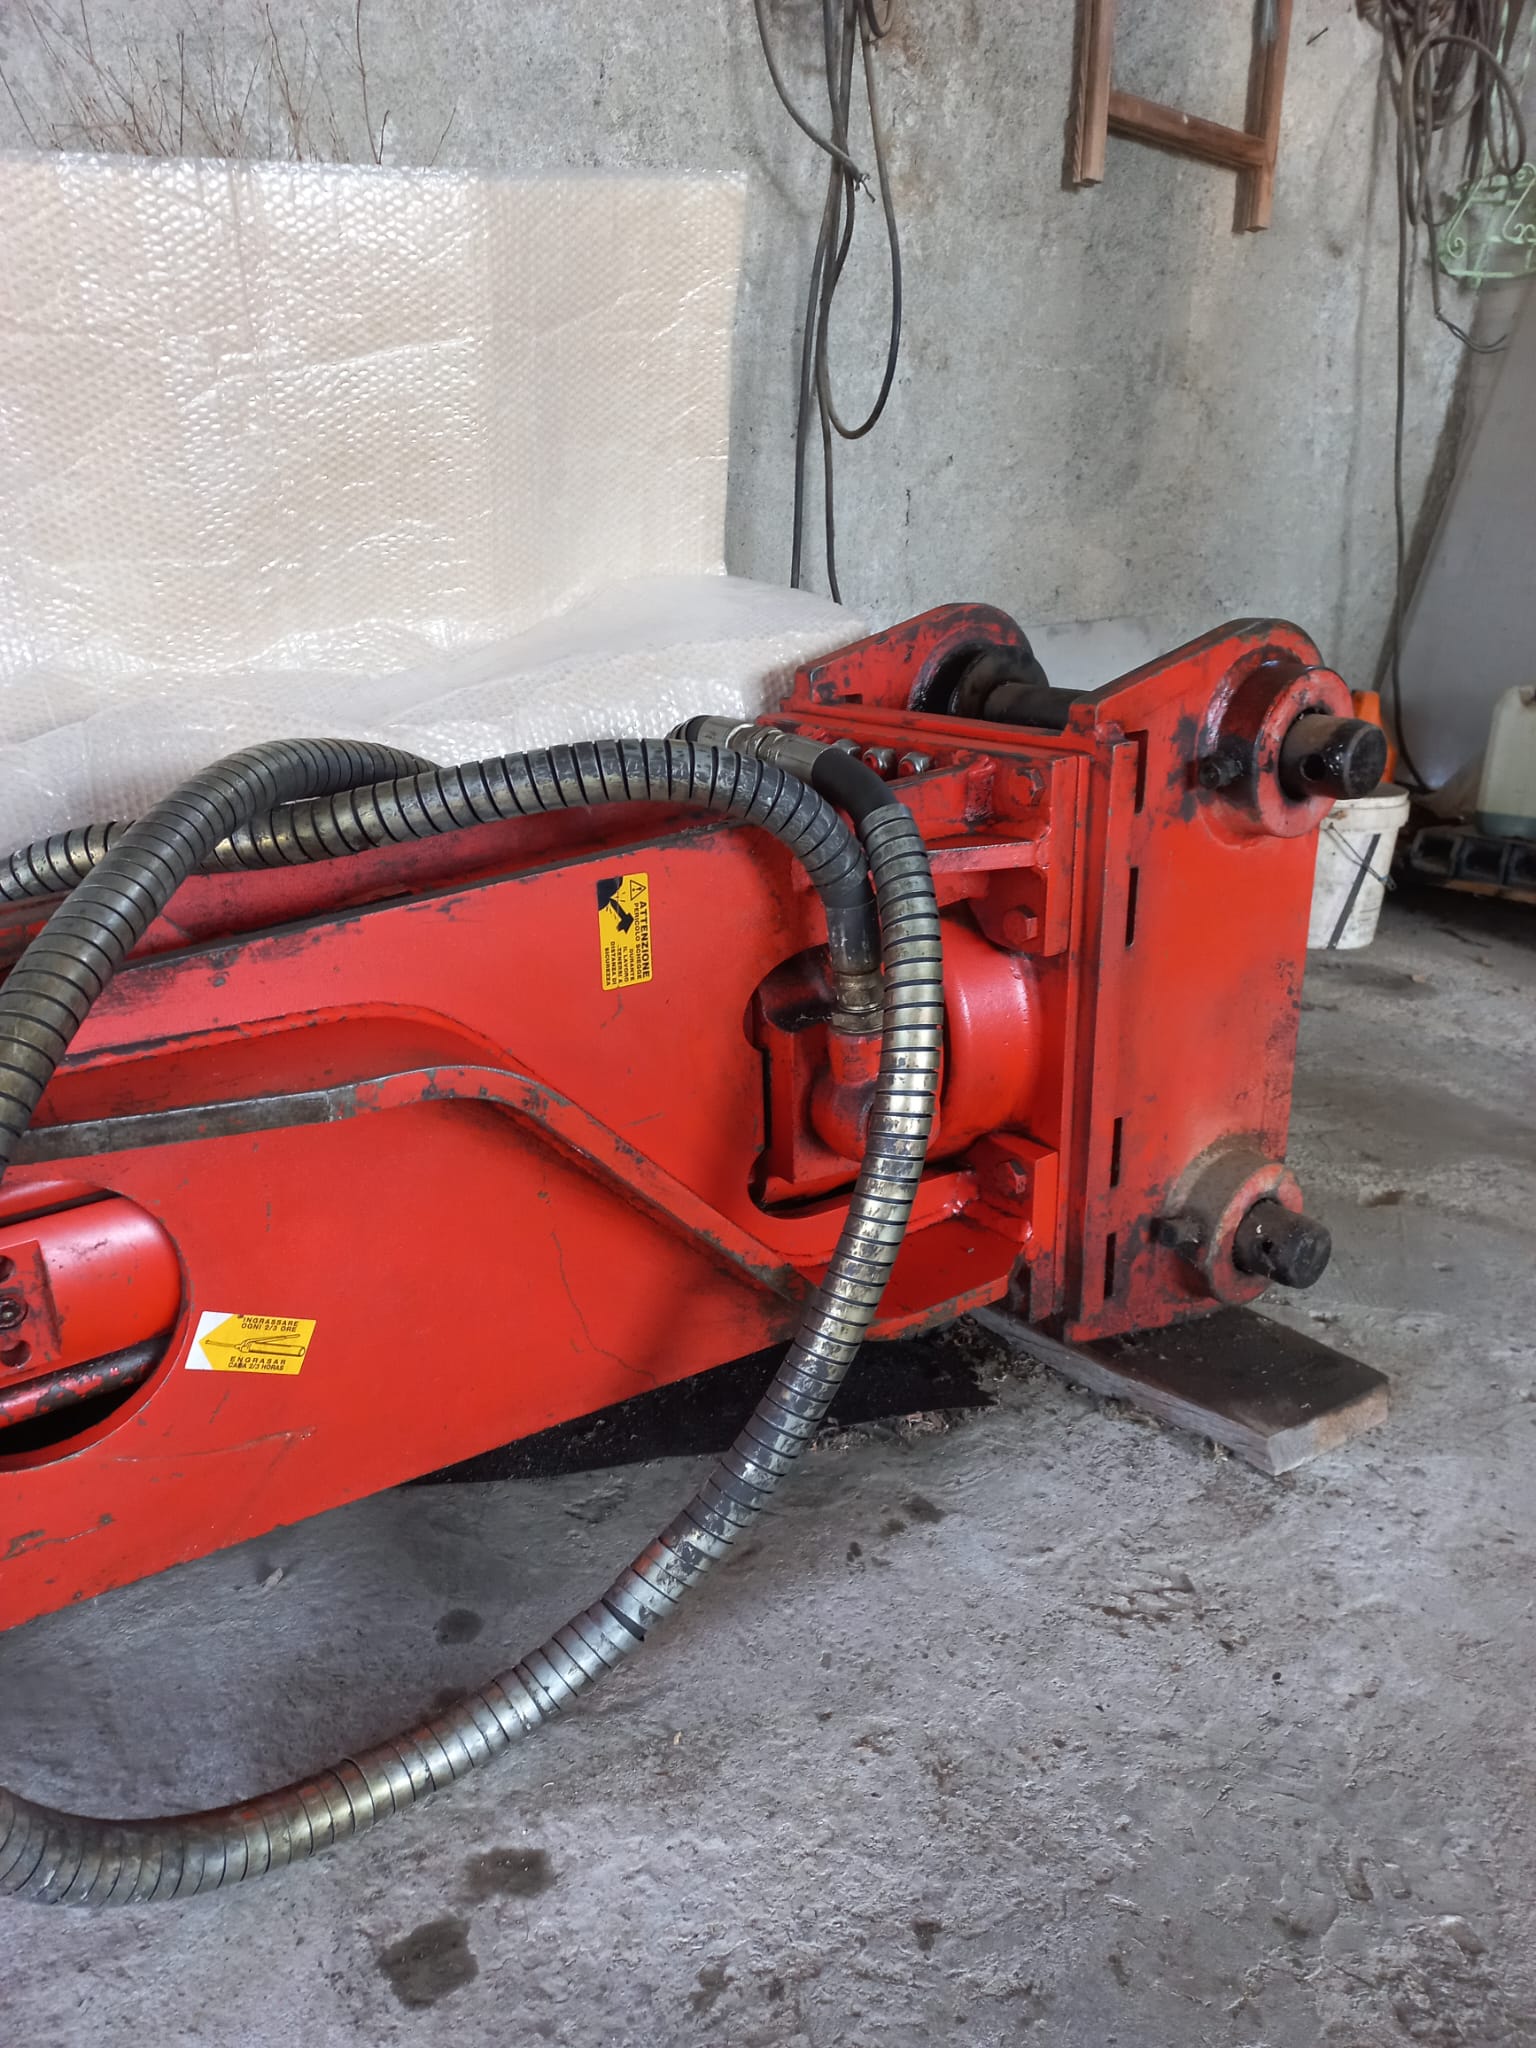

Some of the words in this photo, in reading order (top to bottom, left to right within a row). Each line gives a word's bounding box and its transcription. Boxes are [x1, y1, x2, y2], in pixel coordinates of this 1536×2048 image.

[639, 901, 650, 978] ATTENZIONE
[241, 1322, 262, 1330] OGNI
[243, 1317, 299, 1327] INGRASSARE
[229, 1356, 286, 1365] ENGRASAR
